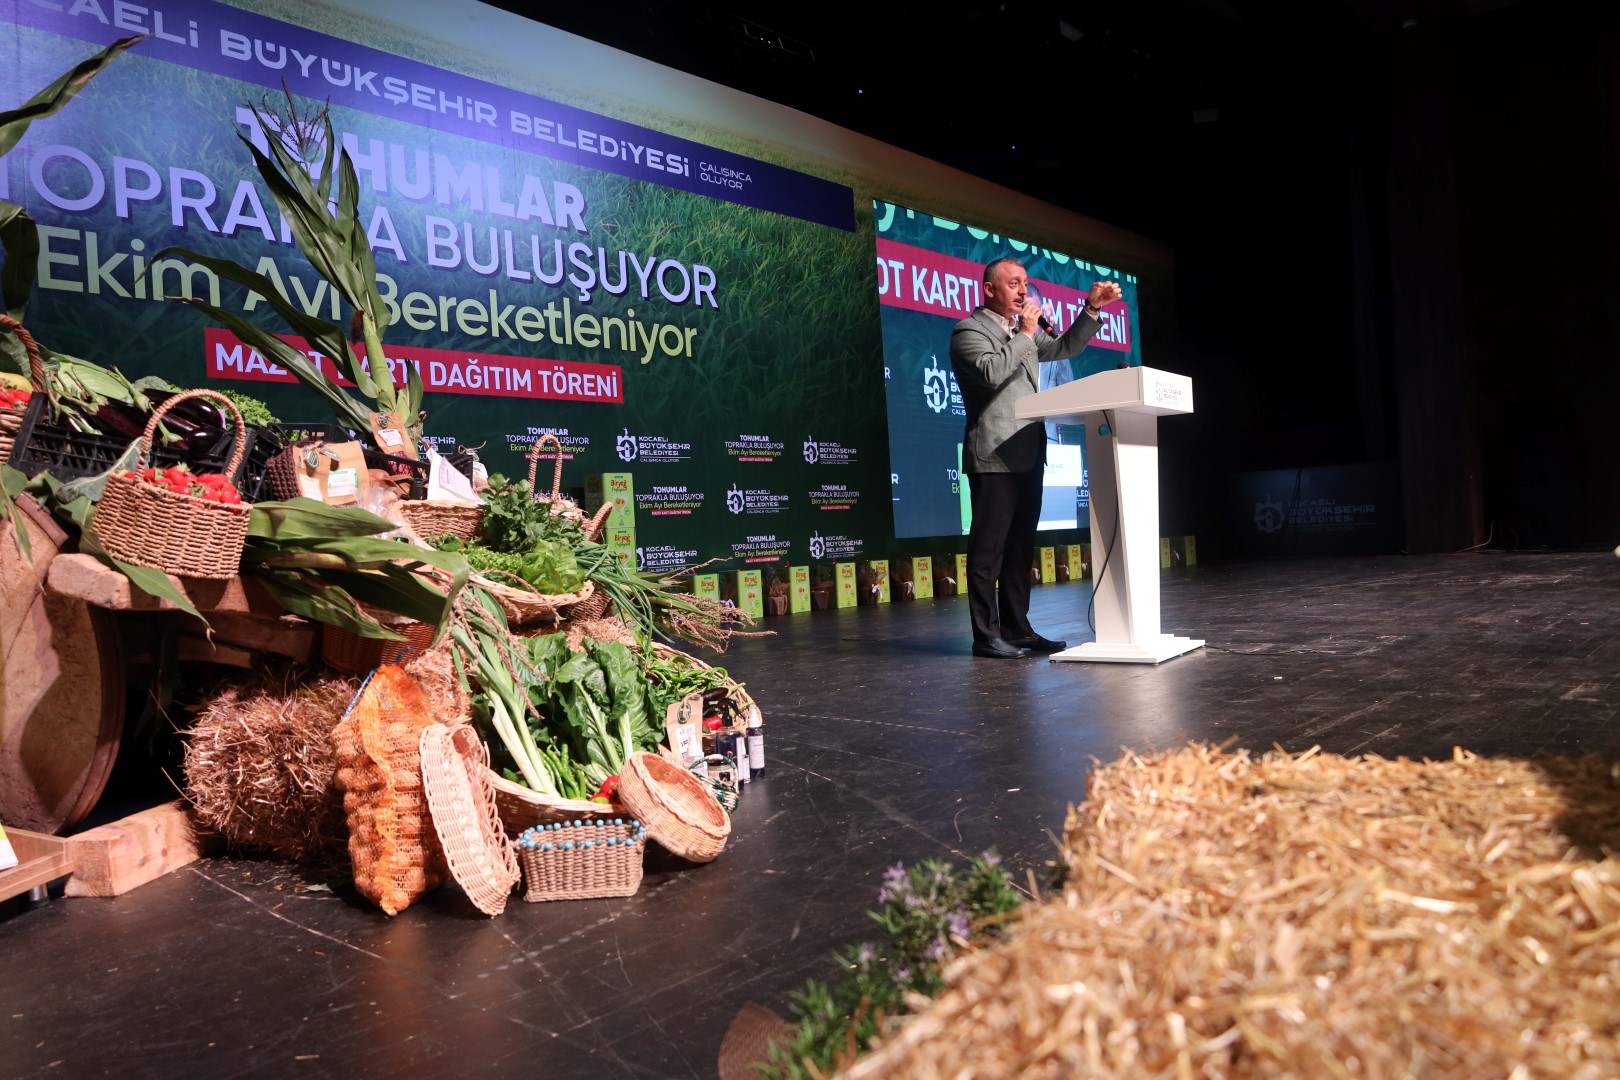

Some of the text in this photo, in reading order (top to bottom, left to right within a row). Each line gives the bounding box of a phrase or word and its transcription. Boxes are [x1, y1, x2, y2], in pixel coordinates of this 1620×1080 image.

[700, 172, 743, 190] OLUYOR
[425, 215, 719, 308] BULUŞUYOR
[912, 264, 980, 313] KARTI
[215, 342, 327, 376] MAZT
[430, 357, 532, 392] DAĞITIM
[538, 364, 618, 398] TÖRENİ
[527, 427, 569, 436] TOHUMLAR
[635, 494, 668, 502] TOPRAKLA
